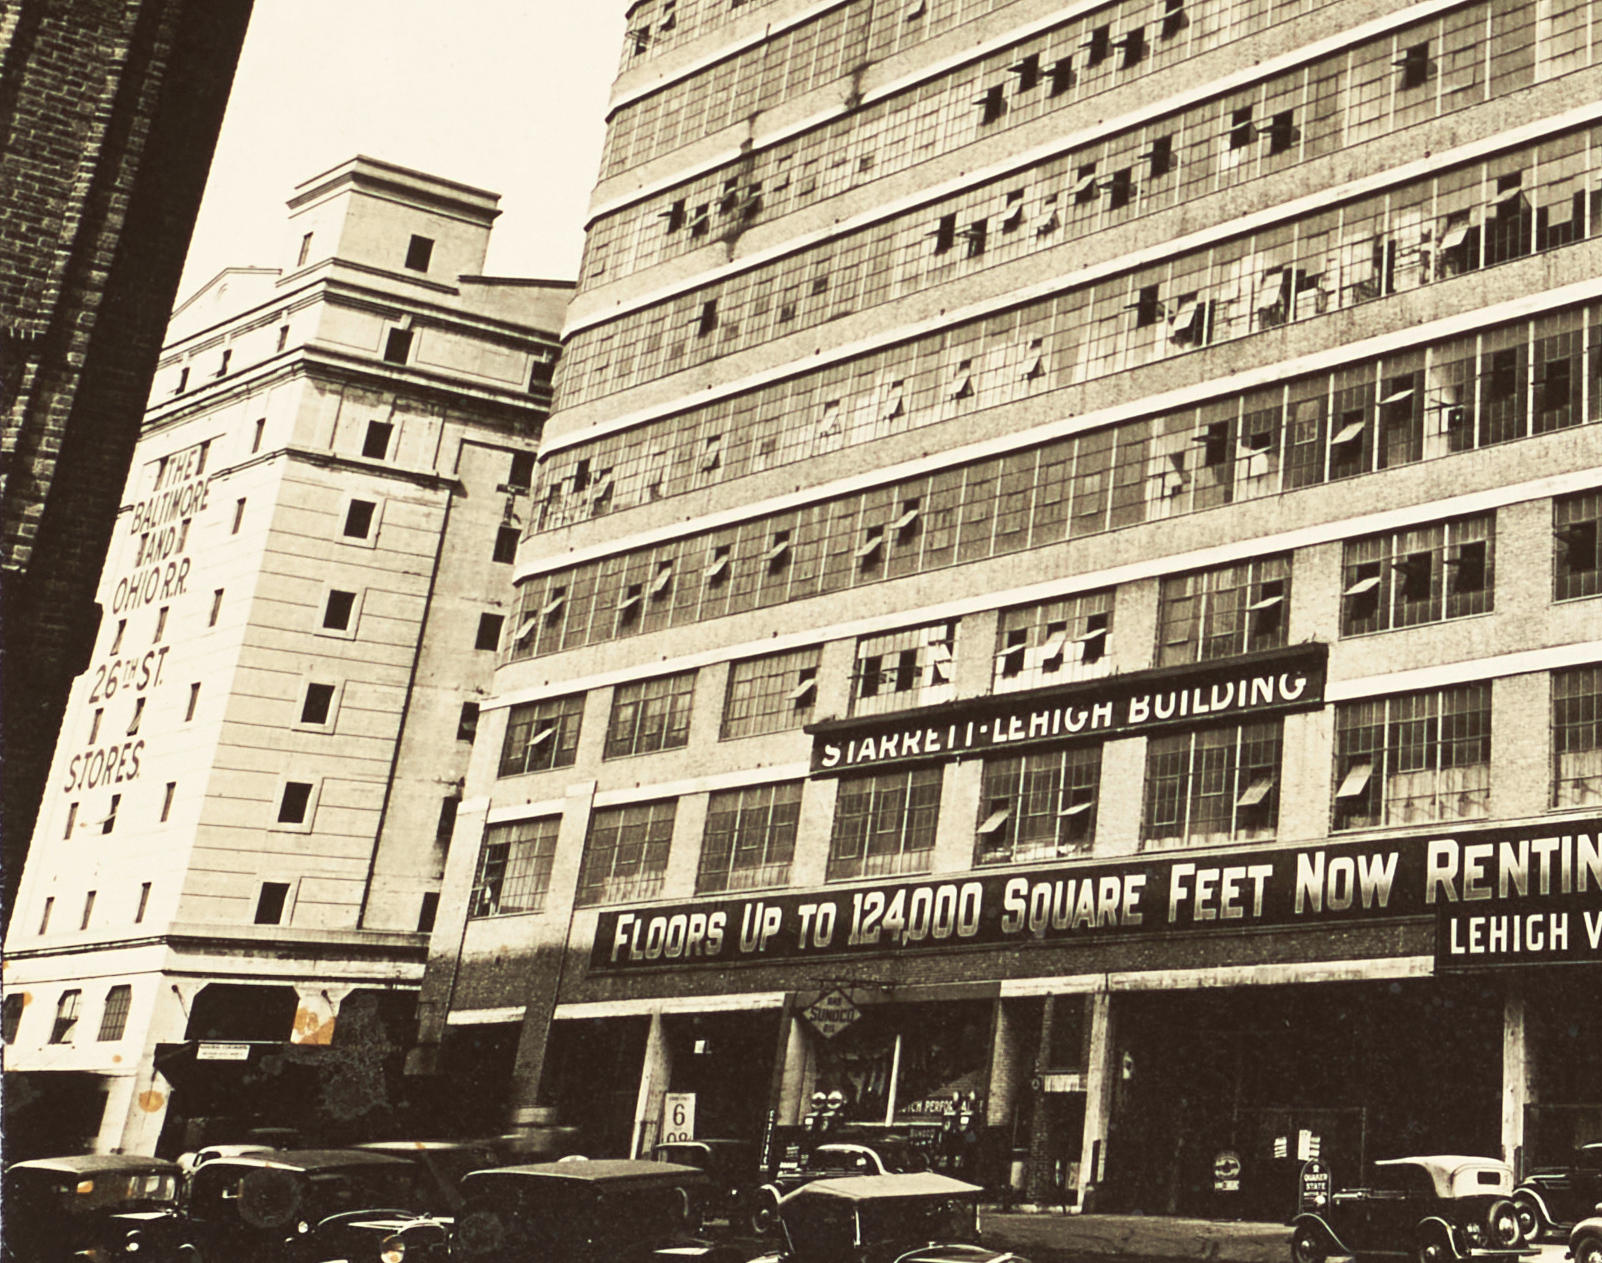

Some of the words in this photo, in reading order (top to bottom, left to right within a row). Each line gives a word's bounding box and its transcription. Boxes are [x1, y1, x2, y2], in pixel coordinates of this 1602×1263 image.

[165, 449, 198, 488] THE
[131, 478, 209, 535] BALTIMORE
[143, 526, 175, 565] AND
[113, 566, 160, 614] OHIO
[1128, 672, 1306, 724] BUILDING
[610, 911, 727, 962] FLOORS
[739, 902, 782, 953] UP
[798, 901, 836, 949] TO
[848, 882, 983, 947] 124,000
[1001, 874, 1147, 934] SQUARE
[1167, 863, 1273, 923] FEET
[1294, 851, 1399, 914] NOW
[1450, 913, 1568, 955] LEHIGH
[673, 1103, 685, 1126] 6
